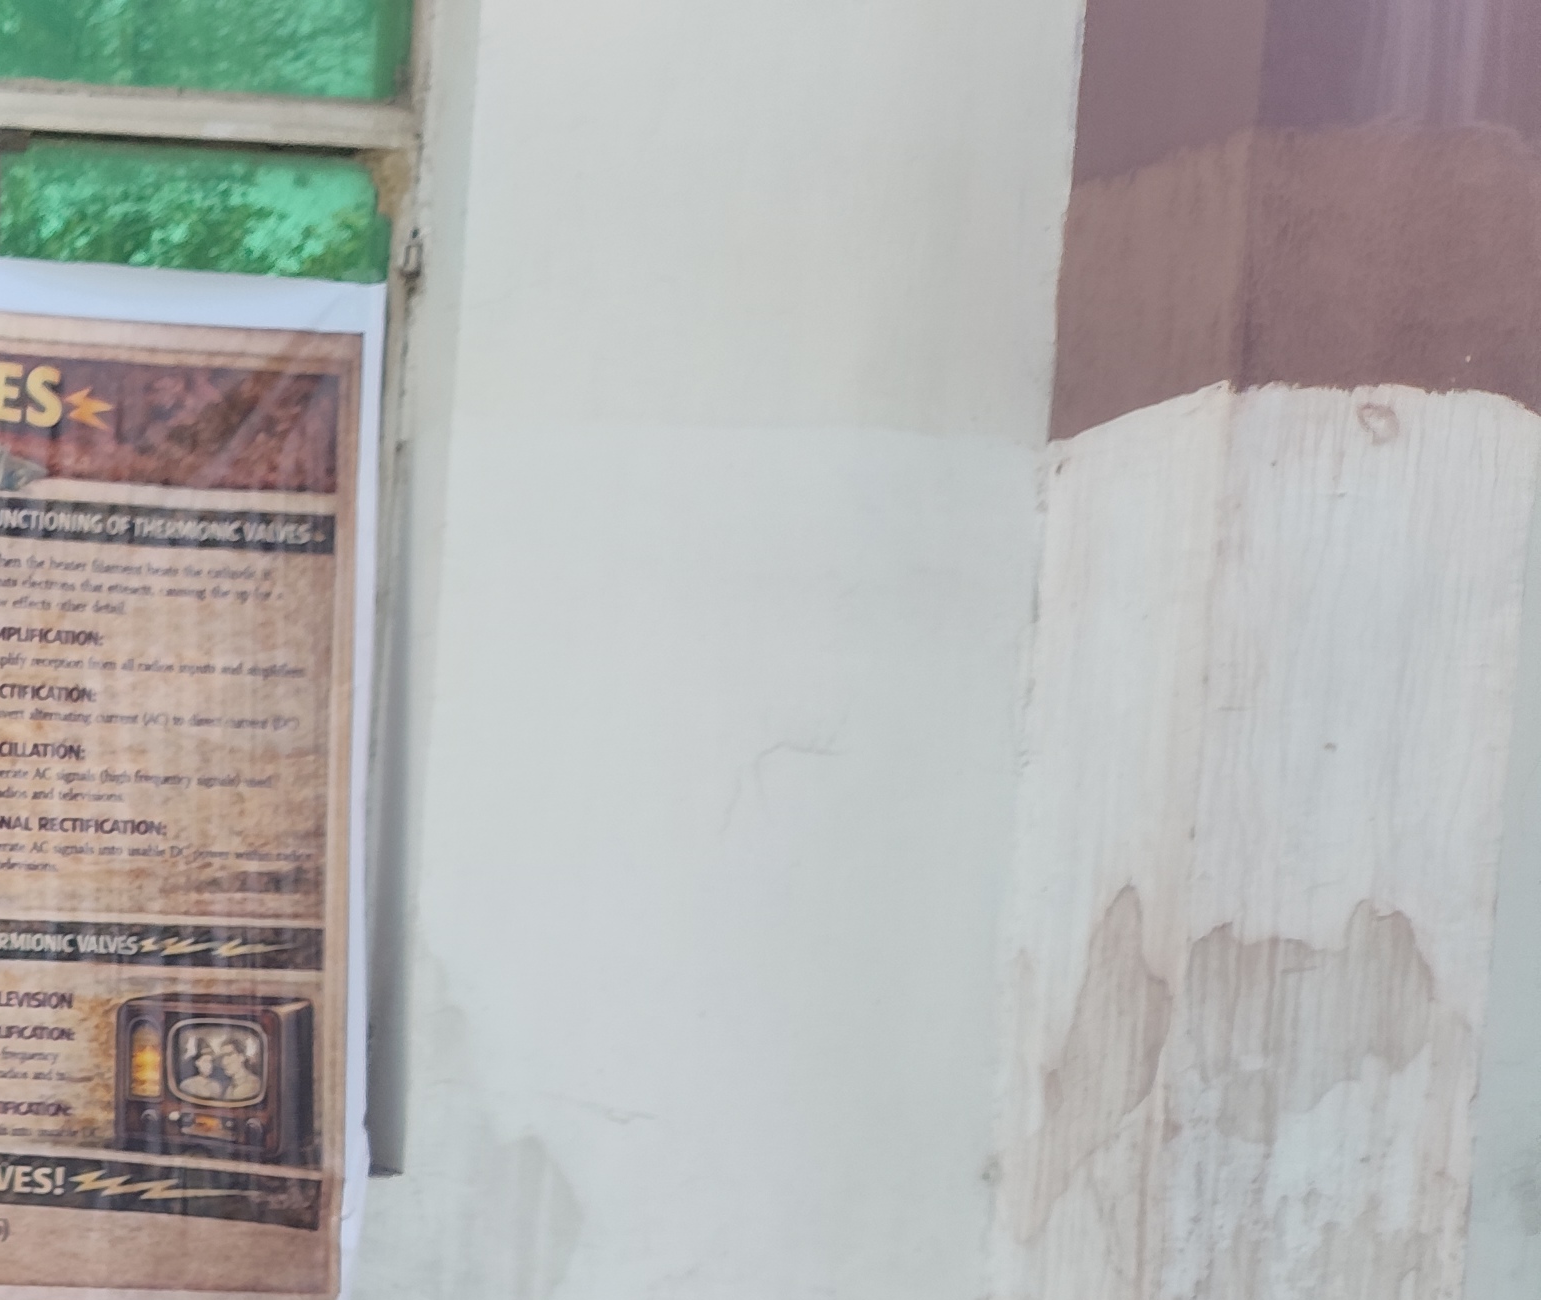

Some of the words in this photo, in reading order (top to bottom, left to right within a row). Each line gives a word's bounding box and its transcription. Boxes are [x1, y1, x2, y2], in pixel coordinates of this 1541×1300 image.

[106, 513, 131, 536] OF
[242, 519, 312, 545] VALVES
[37, 816, 168, 838] RECTIFICATION:
[75, 934, 140, 956] VALVES
